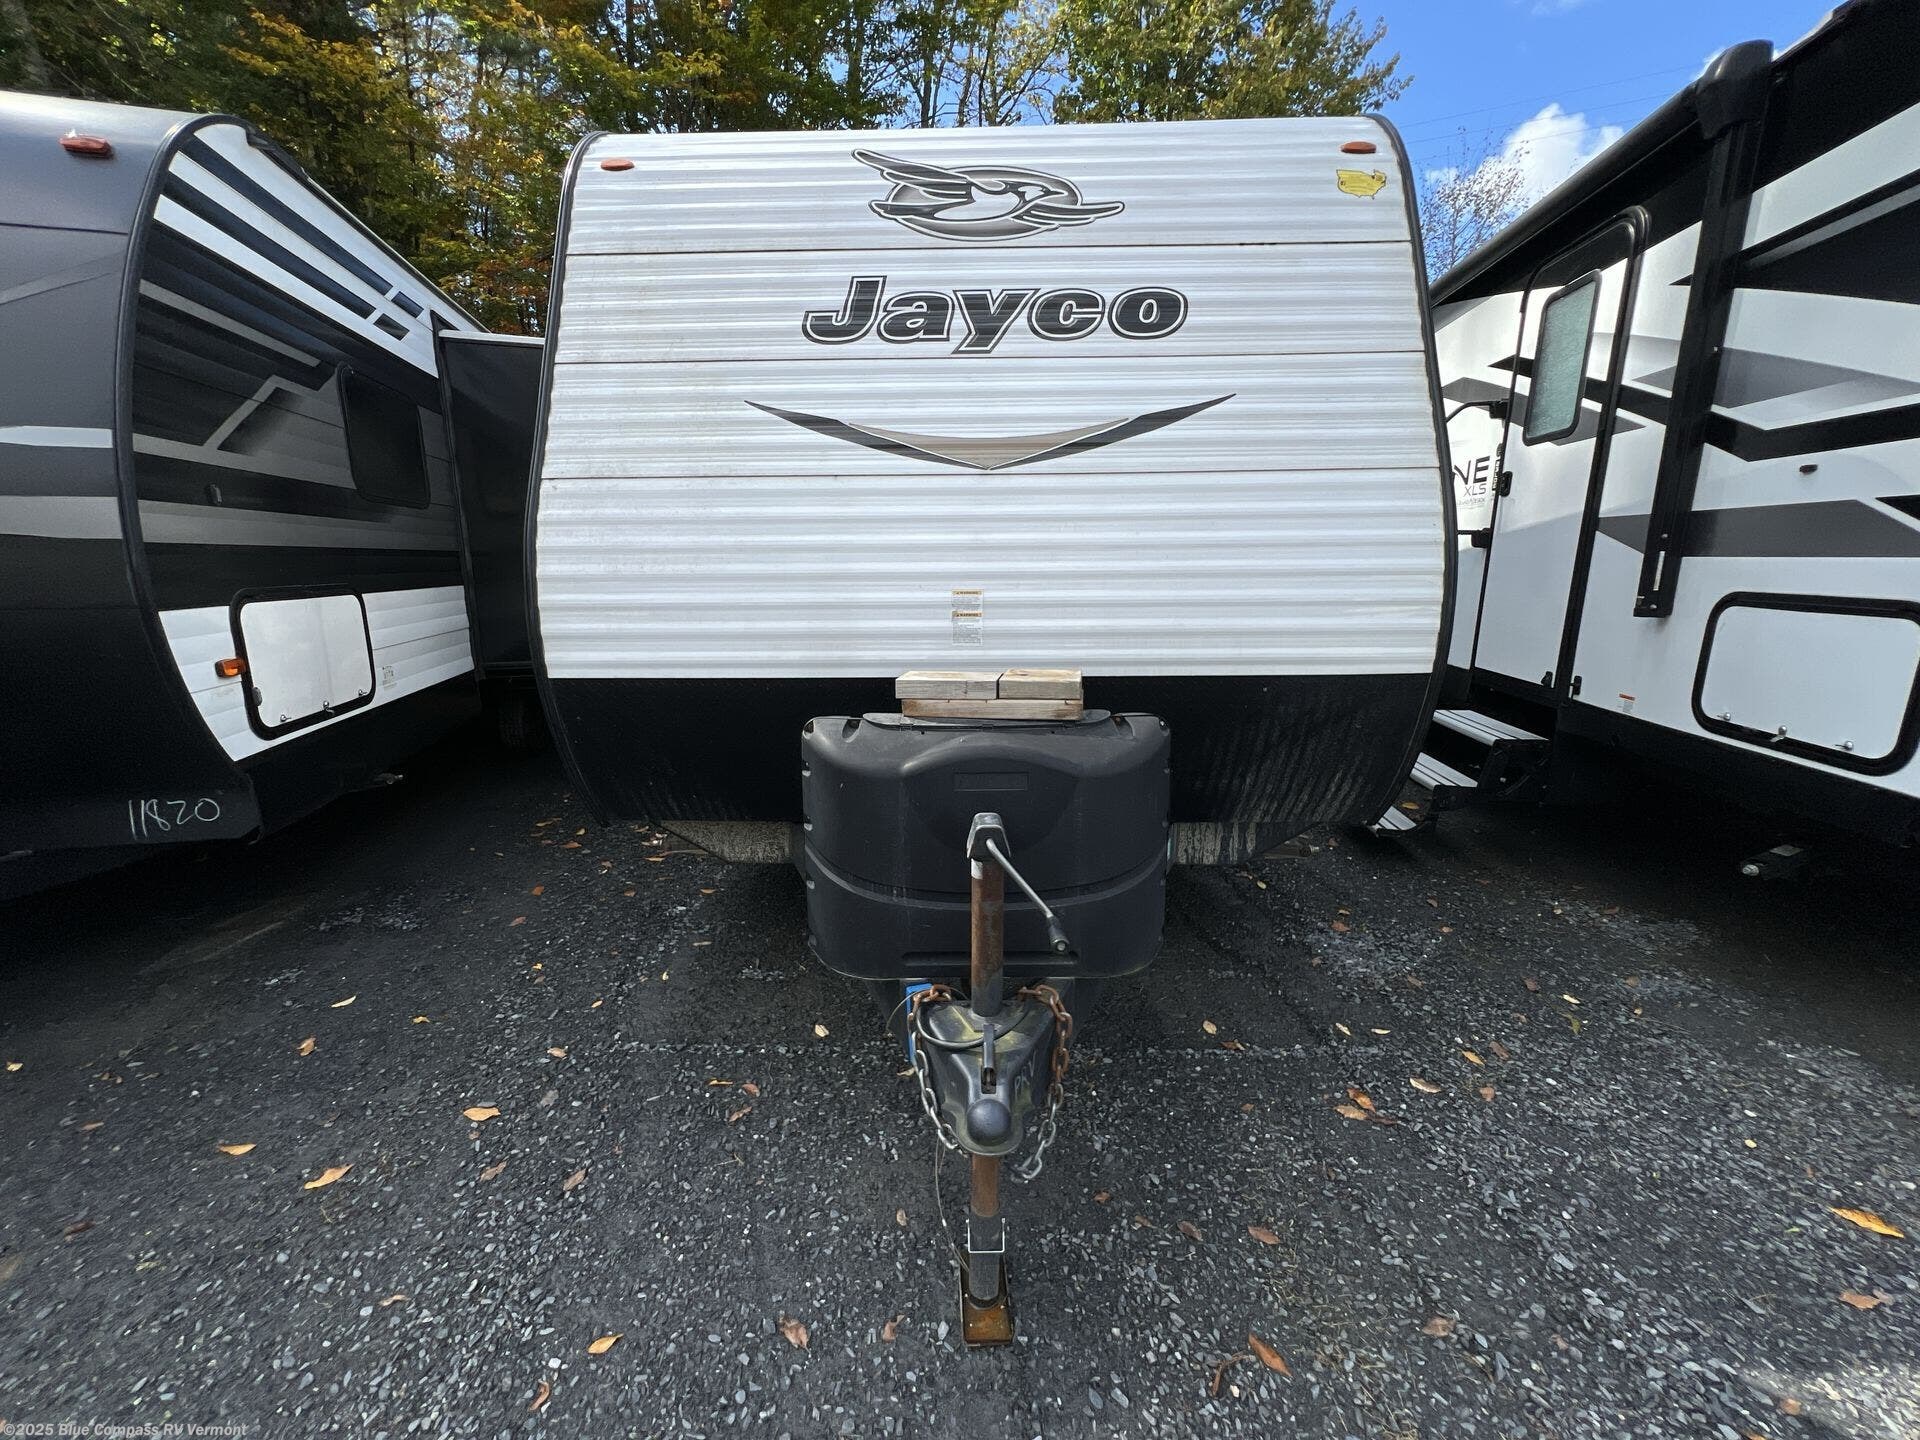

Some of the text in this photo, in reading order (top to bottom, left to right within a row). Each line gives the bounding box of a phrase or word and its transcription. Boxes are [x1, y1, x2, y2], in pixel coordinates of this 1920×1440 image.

[801, 275, 1189, 354] Jayco
[1463, 483, 1487, 497] XLS
[128, 798, 220, 841] 11820
